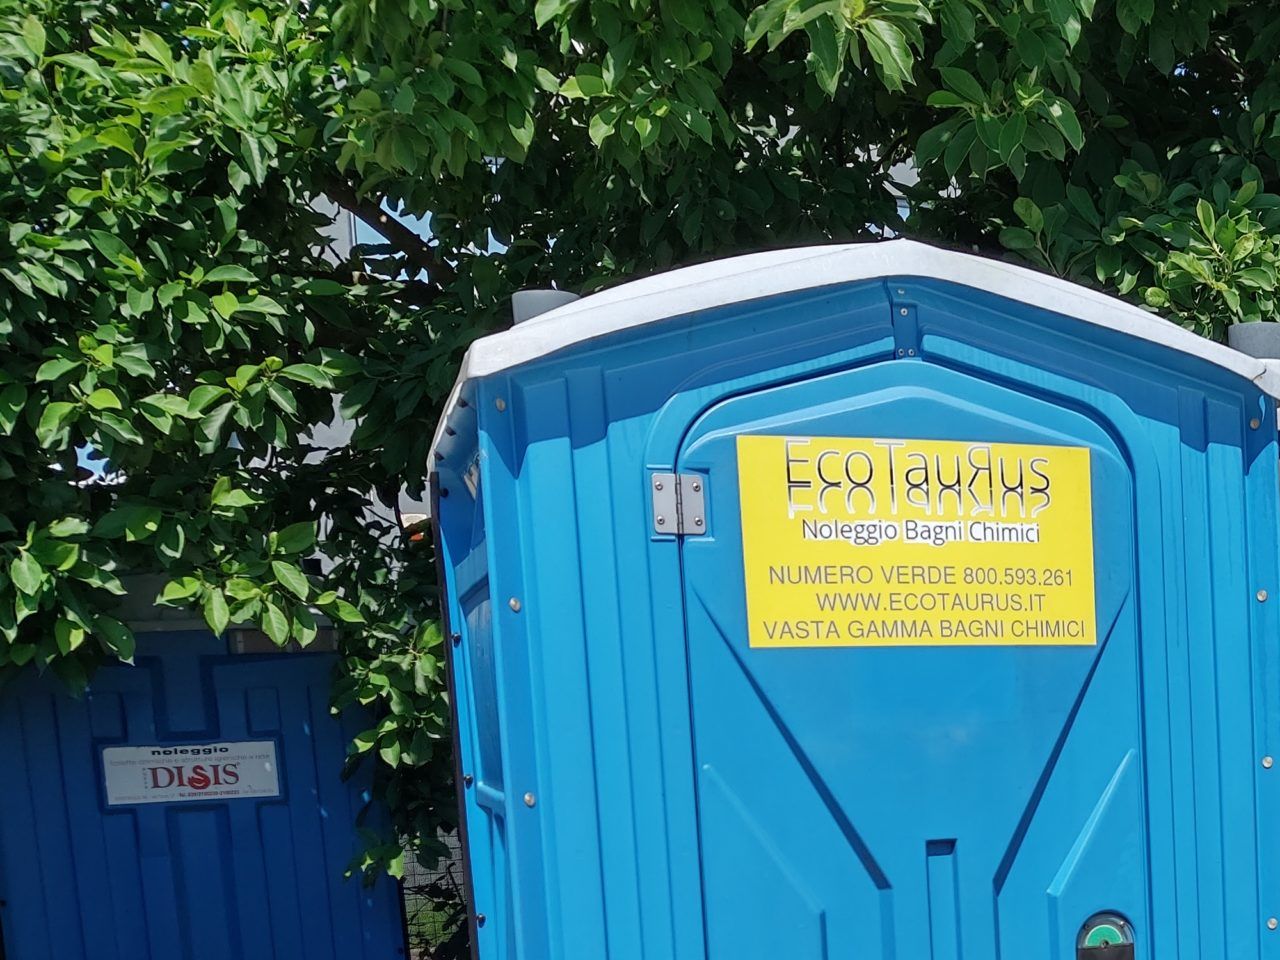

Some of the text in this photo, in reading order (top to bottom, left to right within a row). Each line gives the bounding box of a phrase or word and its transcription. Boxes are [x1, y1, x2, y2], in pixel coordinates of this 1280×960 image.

[802, 519, 1040, 546] Noleggio Bagni Chimici
[769, 565, 1073, 586] NUMERO VERDE 800.593.261
[816, 593, 1046, 612] WWW.ECOTAURUS.IT
[763, 620, 1085, 640] VASTA GAMMA BAGNI CHIMICI
[151, 746, 229, 756] noleggio
